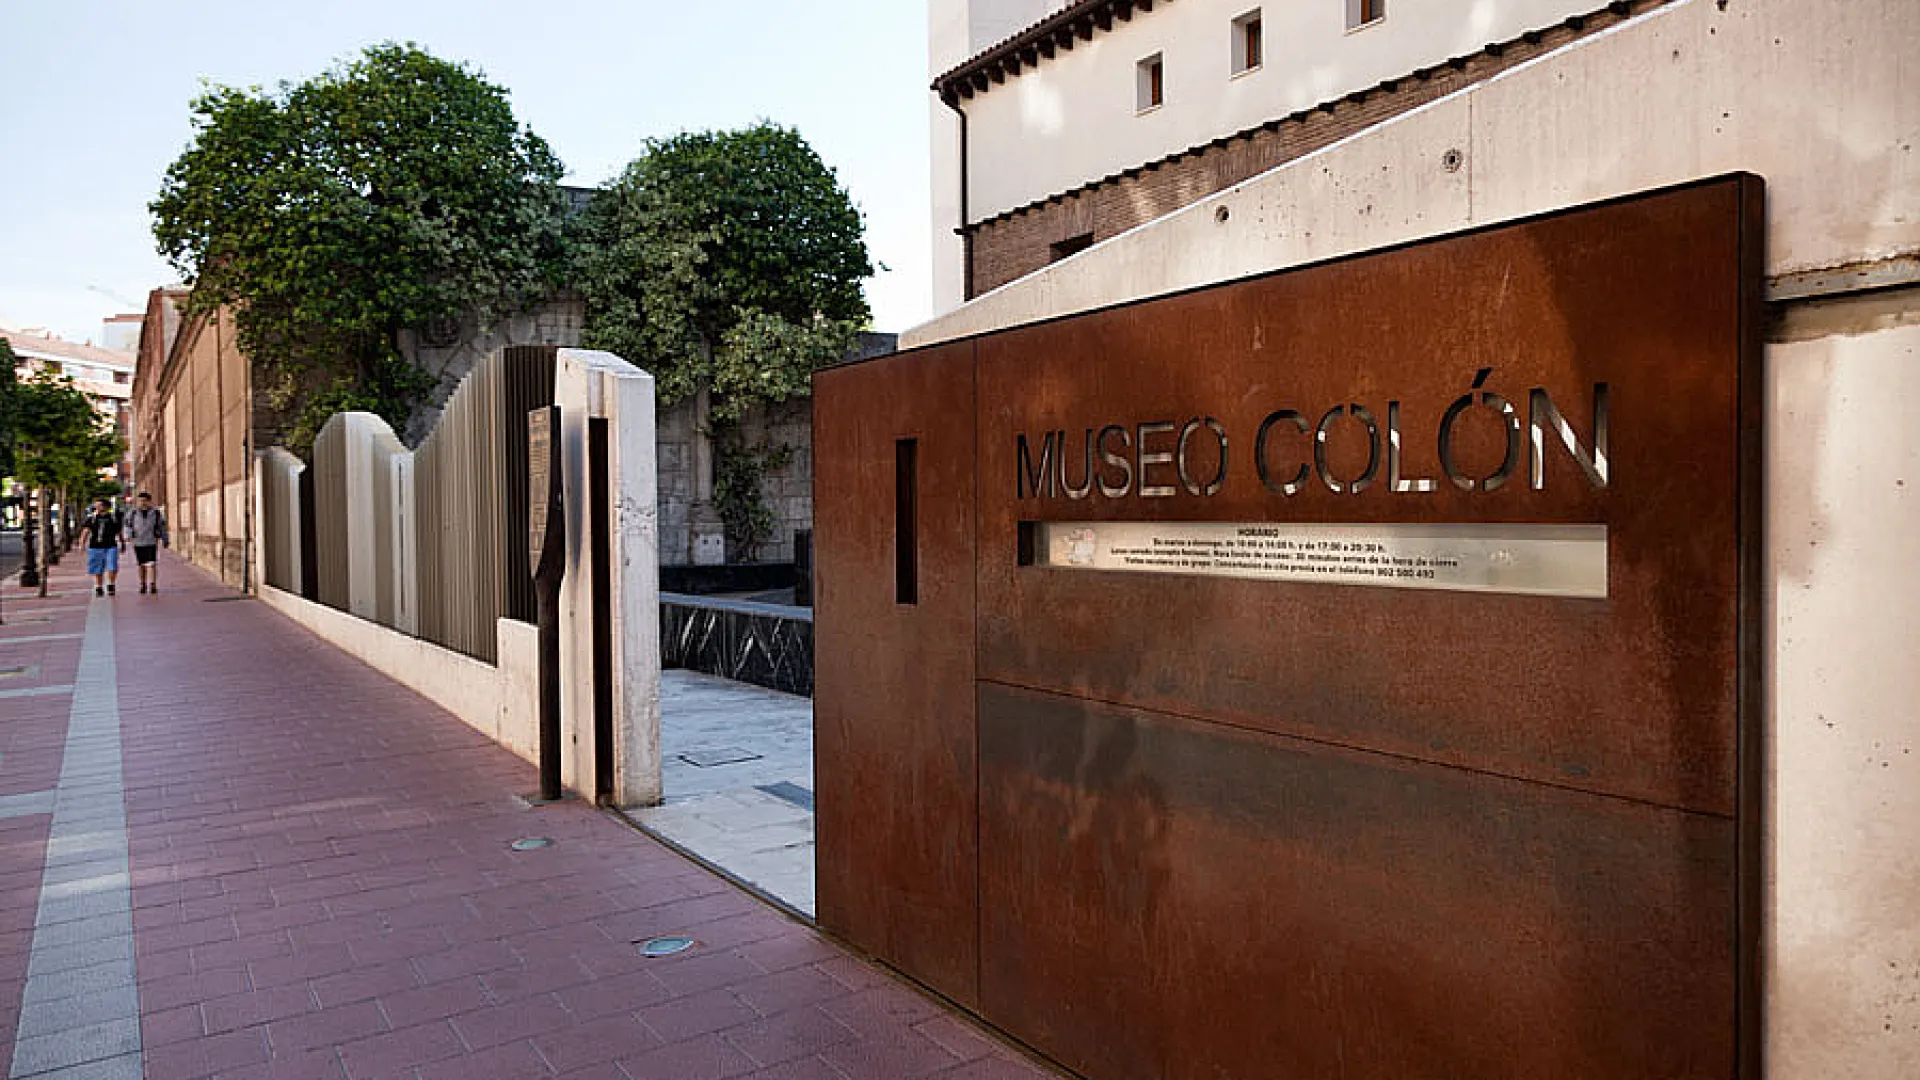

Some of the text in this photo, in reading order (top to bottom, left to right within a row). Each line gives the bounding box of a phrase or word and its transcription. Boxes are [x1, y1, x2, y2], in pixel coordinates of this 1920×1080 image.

[1016, 367, 1609, 499] MUSEO COLÓN
[1237, 528, 1279, 537] HORARIO
[1305, 541, 1315, 549] de
[1367, 555, 1379, 564] de
[1392, 556, 1413, 566] hora
[1415, 556, 1427, 567] de
